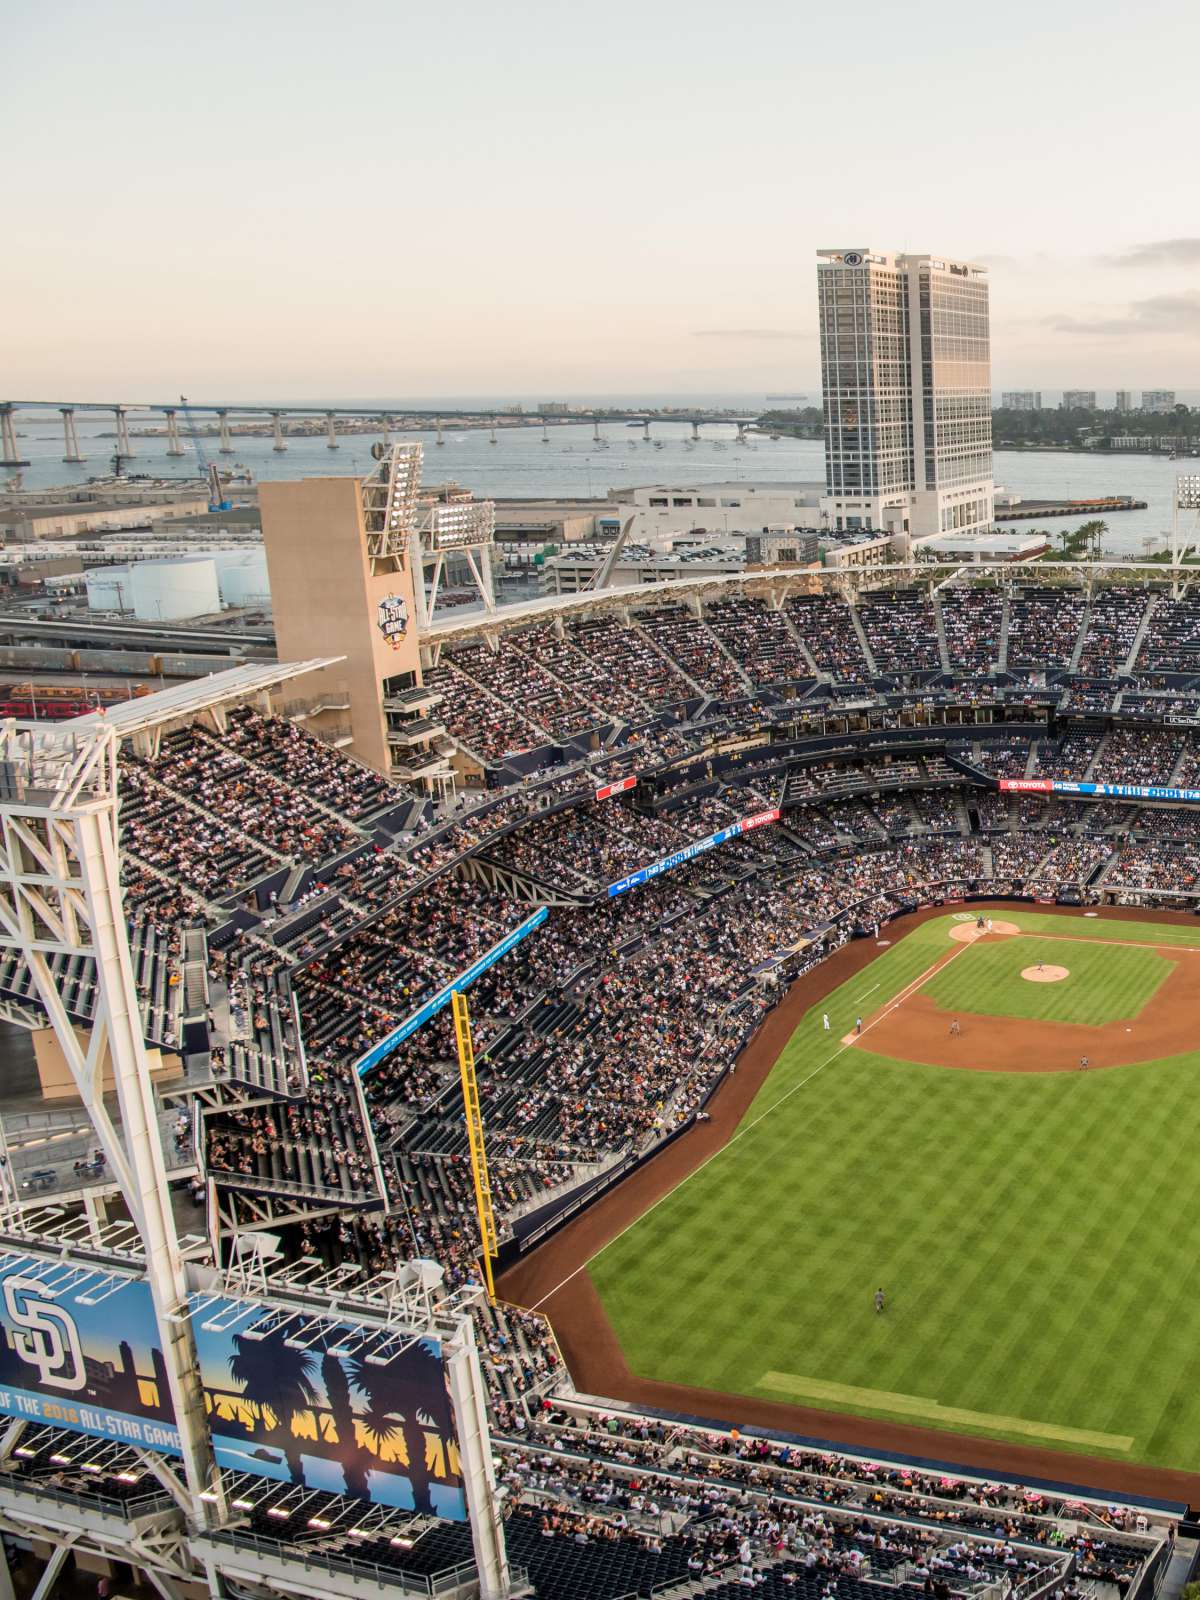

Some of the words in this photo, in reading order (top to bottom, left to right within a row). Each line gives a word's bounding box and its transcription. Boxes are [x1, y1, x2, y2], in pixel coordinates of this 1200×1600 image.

[754, 813, 774, 825] TOYOTA
[14, 1394, 41, 1416] THE
[42, 1402, 79, 1424] 2016
[143, 1423, 183, 1450] GAME
